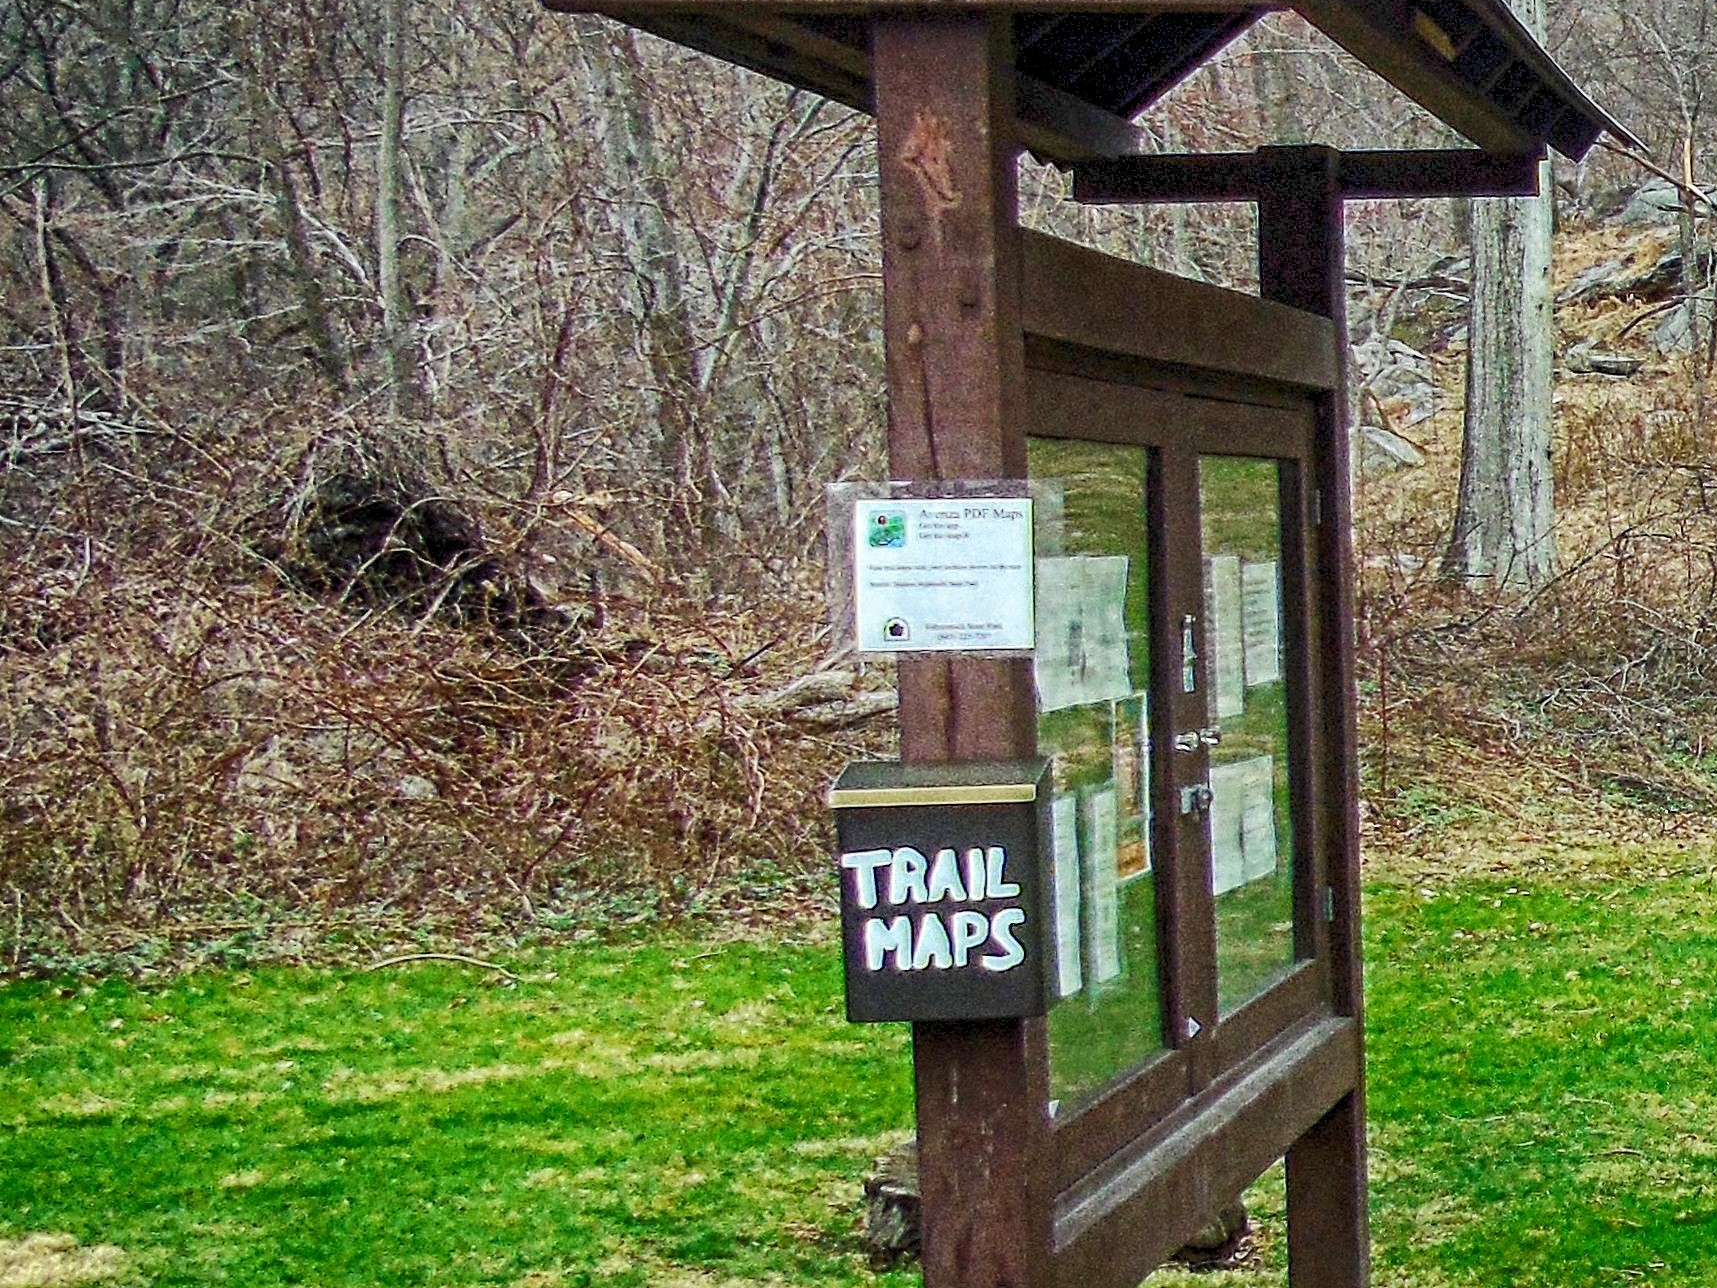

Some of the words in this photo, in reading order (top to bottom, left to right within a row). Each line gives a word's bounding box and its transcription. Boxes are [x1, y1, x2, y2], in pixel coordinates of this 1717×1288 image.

[964, 508, 989, 519] PDF
[993, 508, 1023, 521] Maps
[841, 846, 1022, 909] TRAIL
[864, 908, 1027, 972] MAPS
